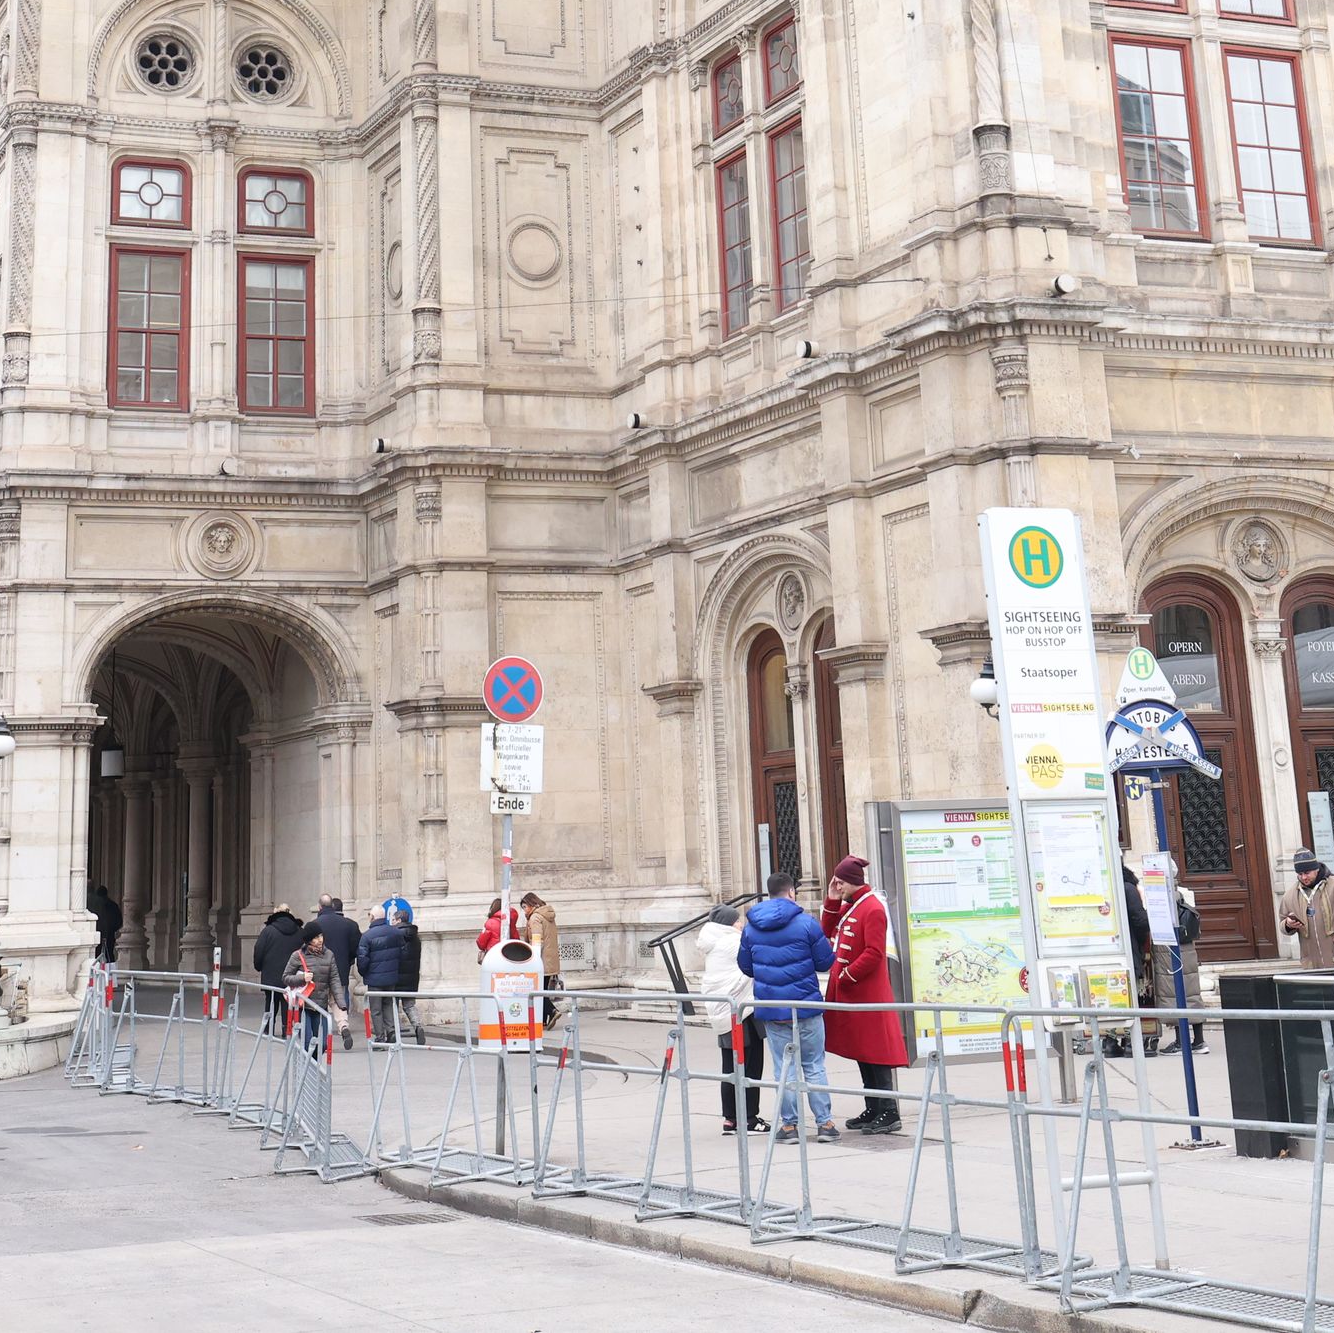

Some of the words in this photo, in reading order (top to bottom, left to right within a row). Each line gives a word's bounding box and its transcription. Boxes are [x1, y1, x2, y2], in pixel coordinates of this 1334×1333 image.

[1021, 538, 1052, 576] H
[1004, 611, 1081, 623] SIGHTSEEING
[1005, 626, 1025, 635] HOP
[1027, 626, 1042, 635] ON
[1044, 626, 1064, 635] HOP
[1066, 625, 1083, 634] OFF
[1025, 638, 1067, 647] BUSSTOP
[1168, 641, 1203, 653] OPERN
[1134, 655, 1149, 675] H
[1020, 667, 1078, 680] Staatsoper
[1171, 674, 1206, 685] ABEND
[1012, 703, 1042, 713] VIENNA
[1025, 756, 1058, 765] VIENNA
[1170, 745, 1216, 774] AUFGELASSEN
[1031, 764, 1065, 779] PASS
[497, 796, 525, 810] Ende
[945, 813, 974, 822] VIENNA
